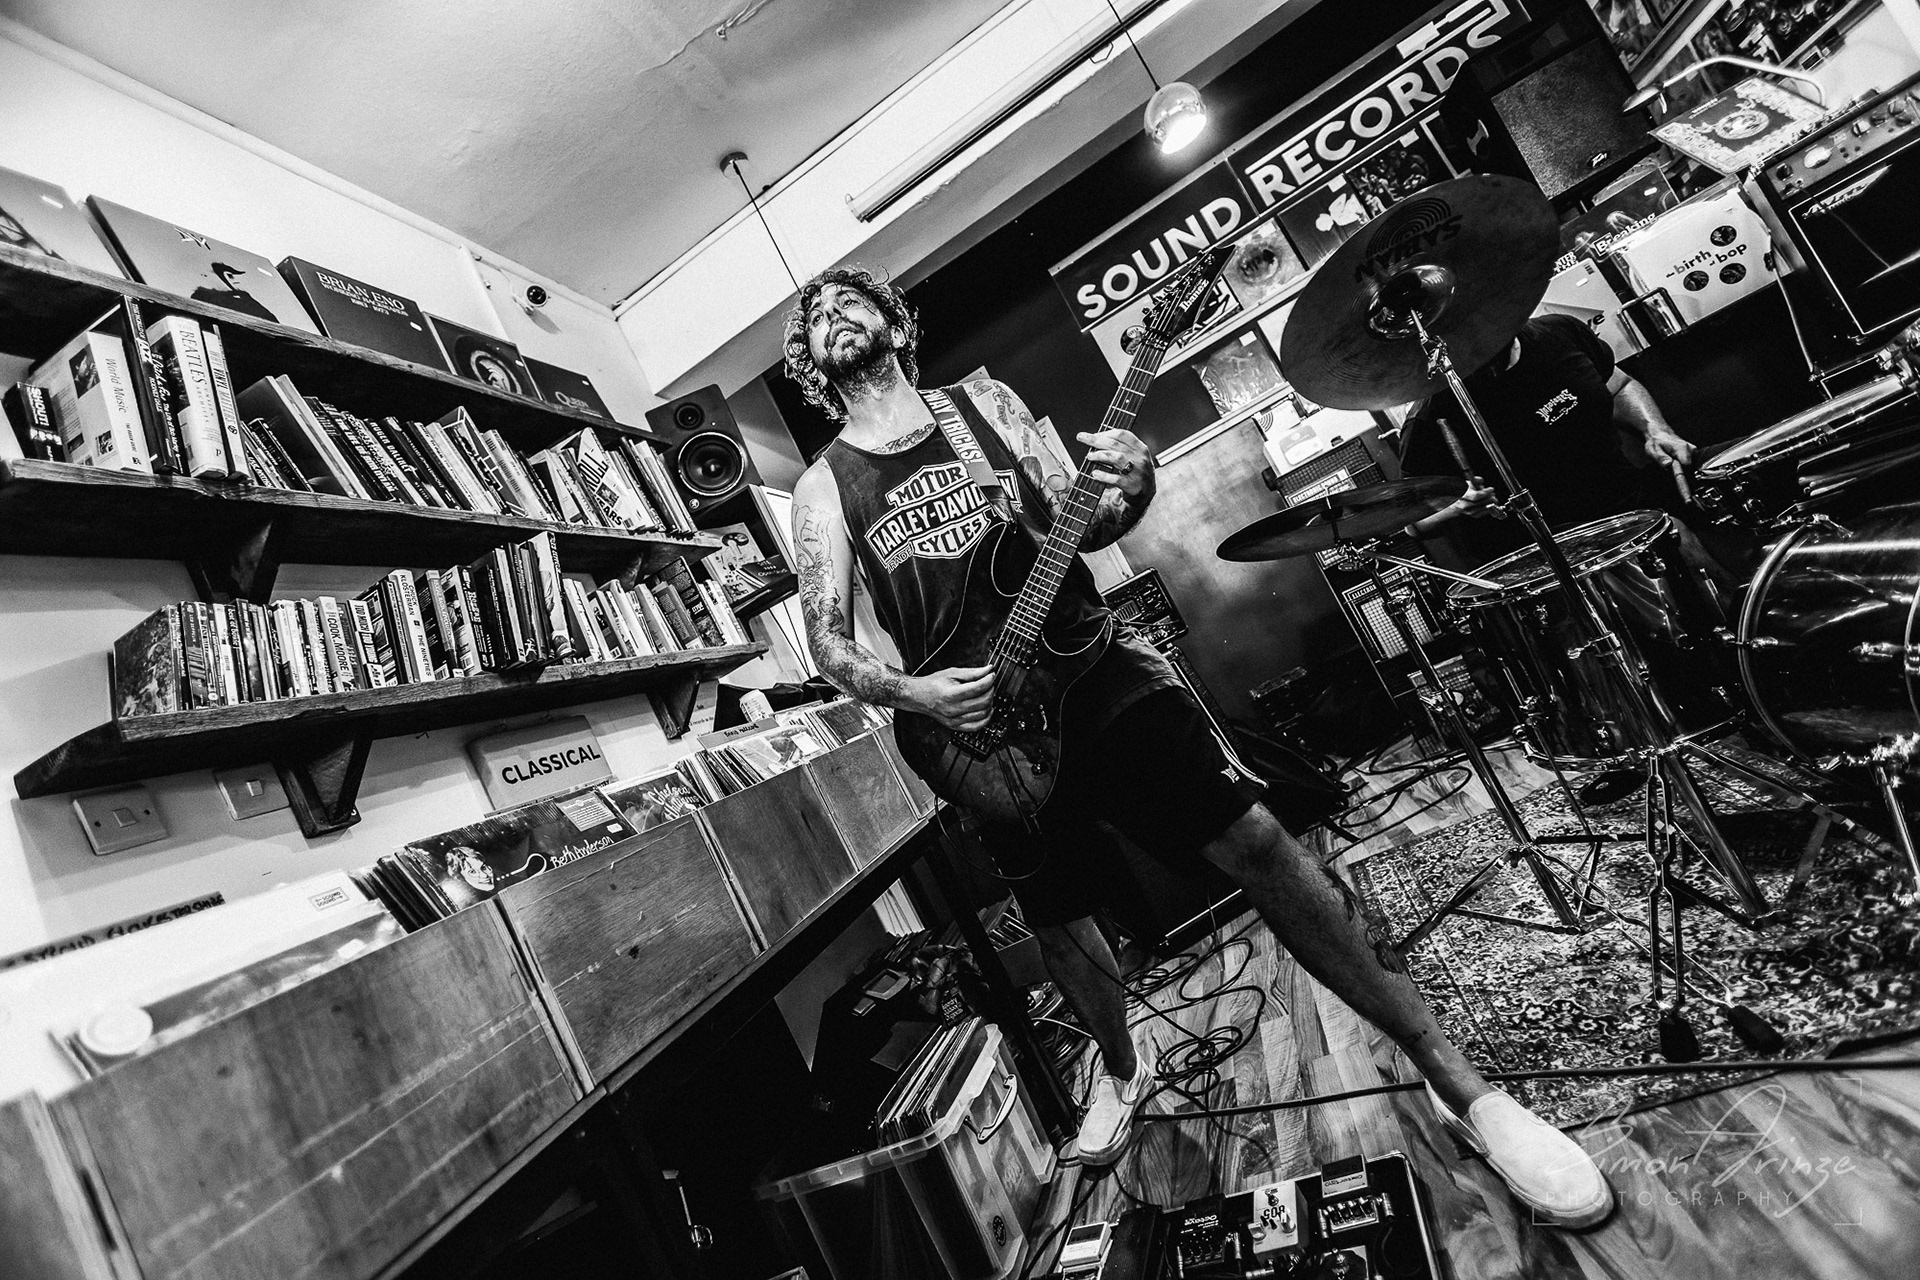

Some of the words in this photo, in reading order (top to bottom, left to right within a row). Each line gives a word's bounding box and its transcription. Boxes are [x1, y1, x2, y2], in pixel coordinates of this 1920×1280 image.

[1076, 196, 1242, 320] SOUND
[1249, 14, 1502, 206] RECORDS
[1595, 212, 1654, 254] Breaking
[1673, 248, 1712, 273] birth
[1715, 241, 1748, 265] bop
[316, 271, 369, 299] BRIAN
[371, 291, 405, 310] ENO
[1178, 279, 1210, 313] Ibanez
[105, 358, 122, 384] World
[179, 330, 207, 385] BEATLES
[213, 368, 229, 390] VINYL
[30, 387, 49, 426] SHOUT!
[112, 387, 129, 413] Music
[939, 413, 986, 465] TRICKS!
[344, 431, 361, 446] LIFE
[354, 445, 368, 456] OF
[373, 471, 395, 493] DYLAN
[895, 464, 963, 504] MOTOR
[917, 516, 983, 553] CYCLES
[399, 574, 415, 616] KLOSTERMAN
[408, 585, 418, 606] CHUCK
[227, 608, 235, 621] best
[229, 620, 237, 628] of
[354, 604, 367, 616] TOO
[357, 616, 370, 632] MUCH
[230, 628, 239, 646] bowie
[417, 634, 425, 646] THE
[419, 647, 432, 676] NINETIES
[501, 744, 602, 786] CLASSICAL
[649, 782, 691, 806] Chelsea
[550, 845, 576, 869] Beth
[574, 834, 615, 861] Anderson
